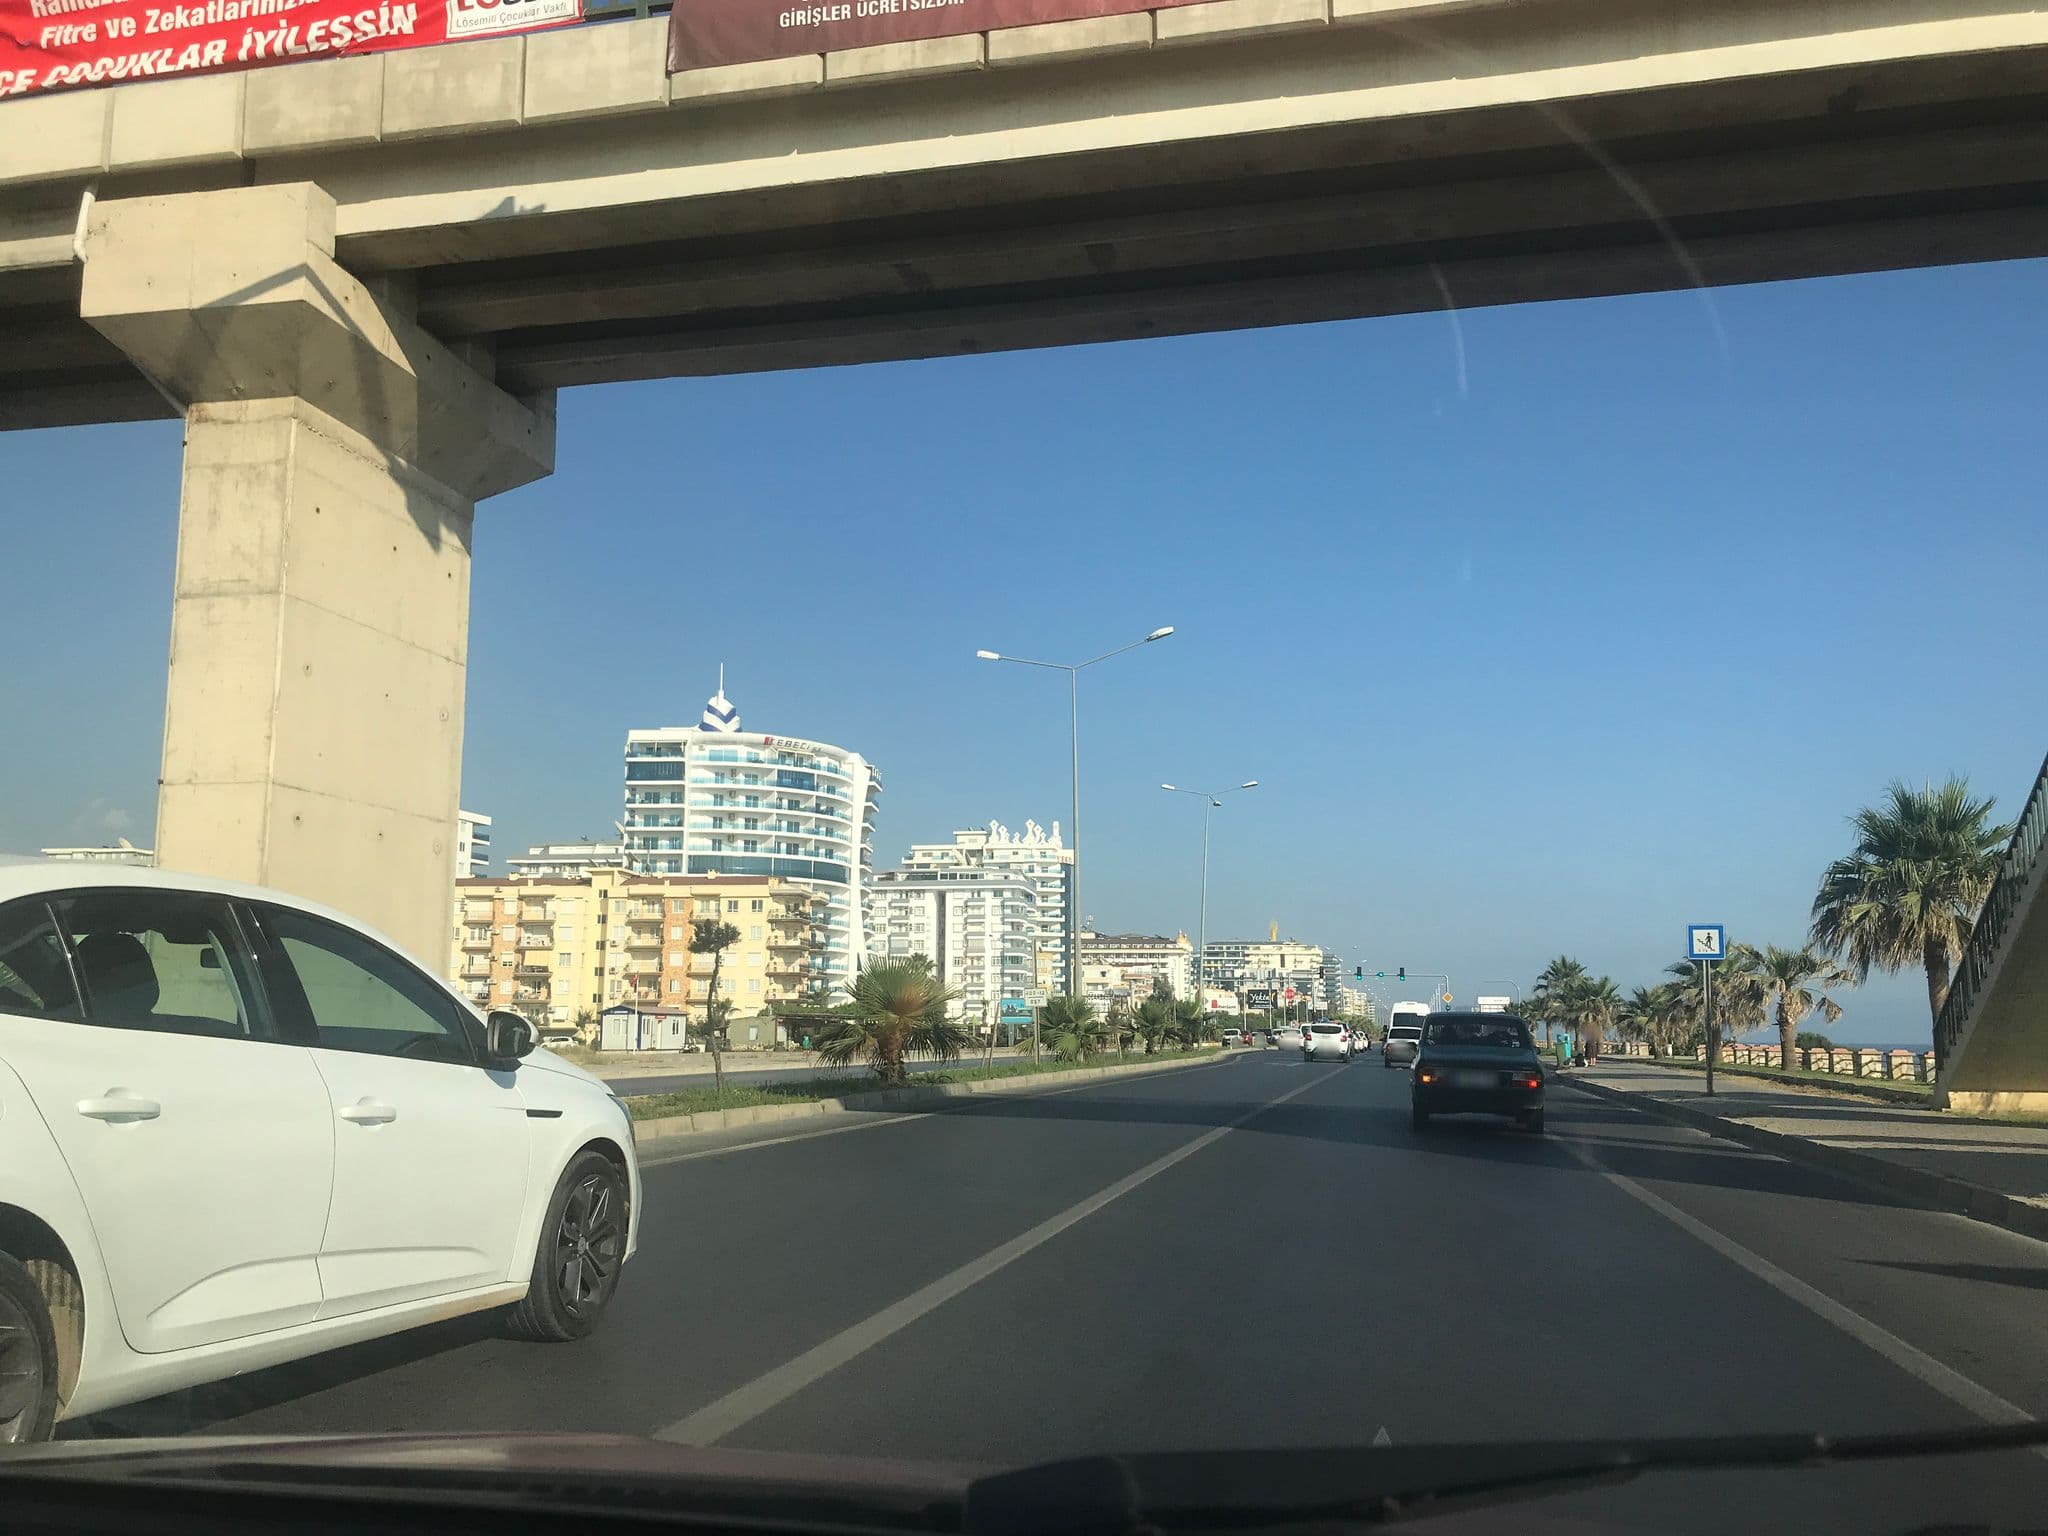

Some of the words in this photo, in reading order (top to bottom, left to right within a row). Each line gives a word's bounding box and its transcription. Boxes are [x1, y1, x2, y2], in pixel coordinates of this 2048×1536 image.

[31, 0, 129, 18] Rama
[500, 6, 541, 24] Çocuklar
[779, 4, 852, 27] GİRİŞLER
[41, 23, 97, 48] Fitre
[105, 16, 137, 38] ve
[145, 0, 320, 34] Zekatlarınız
